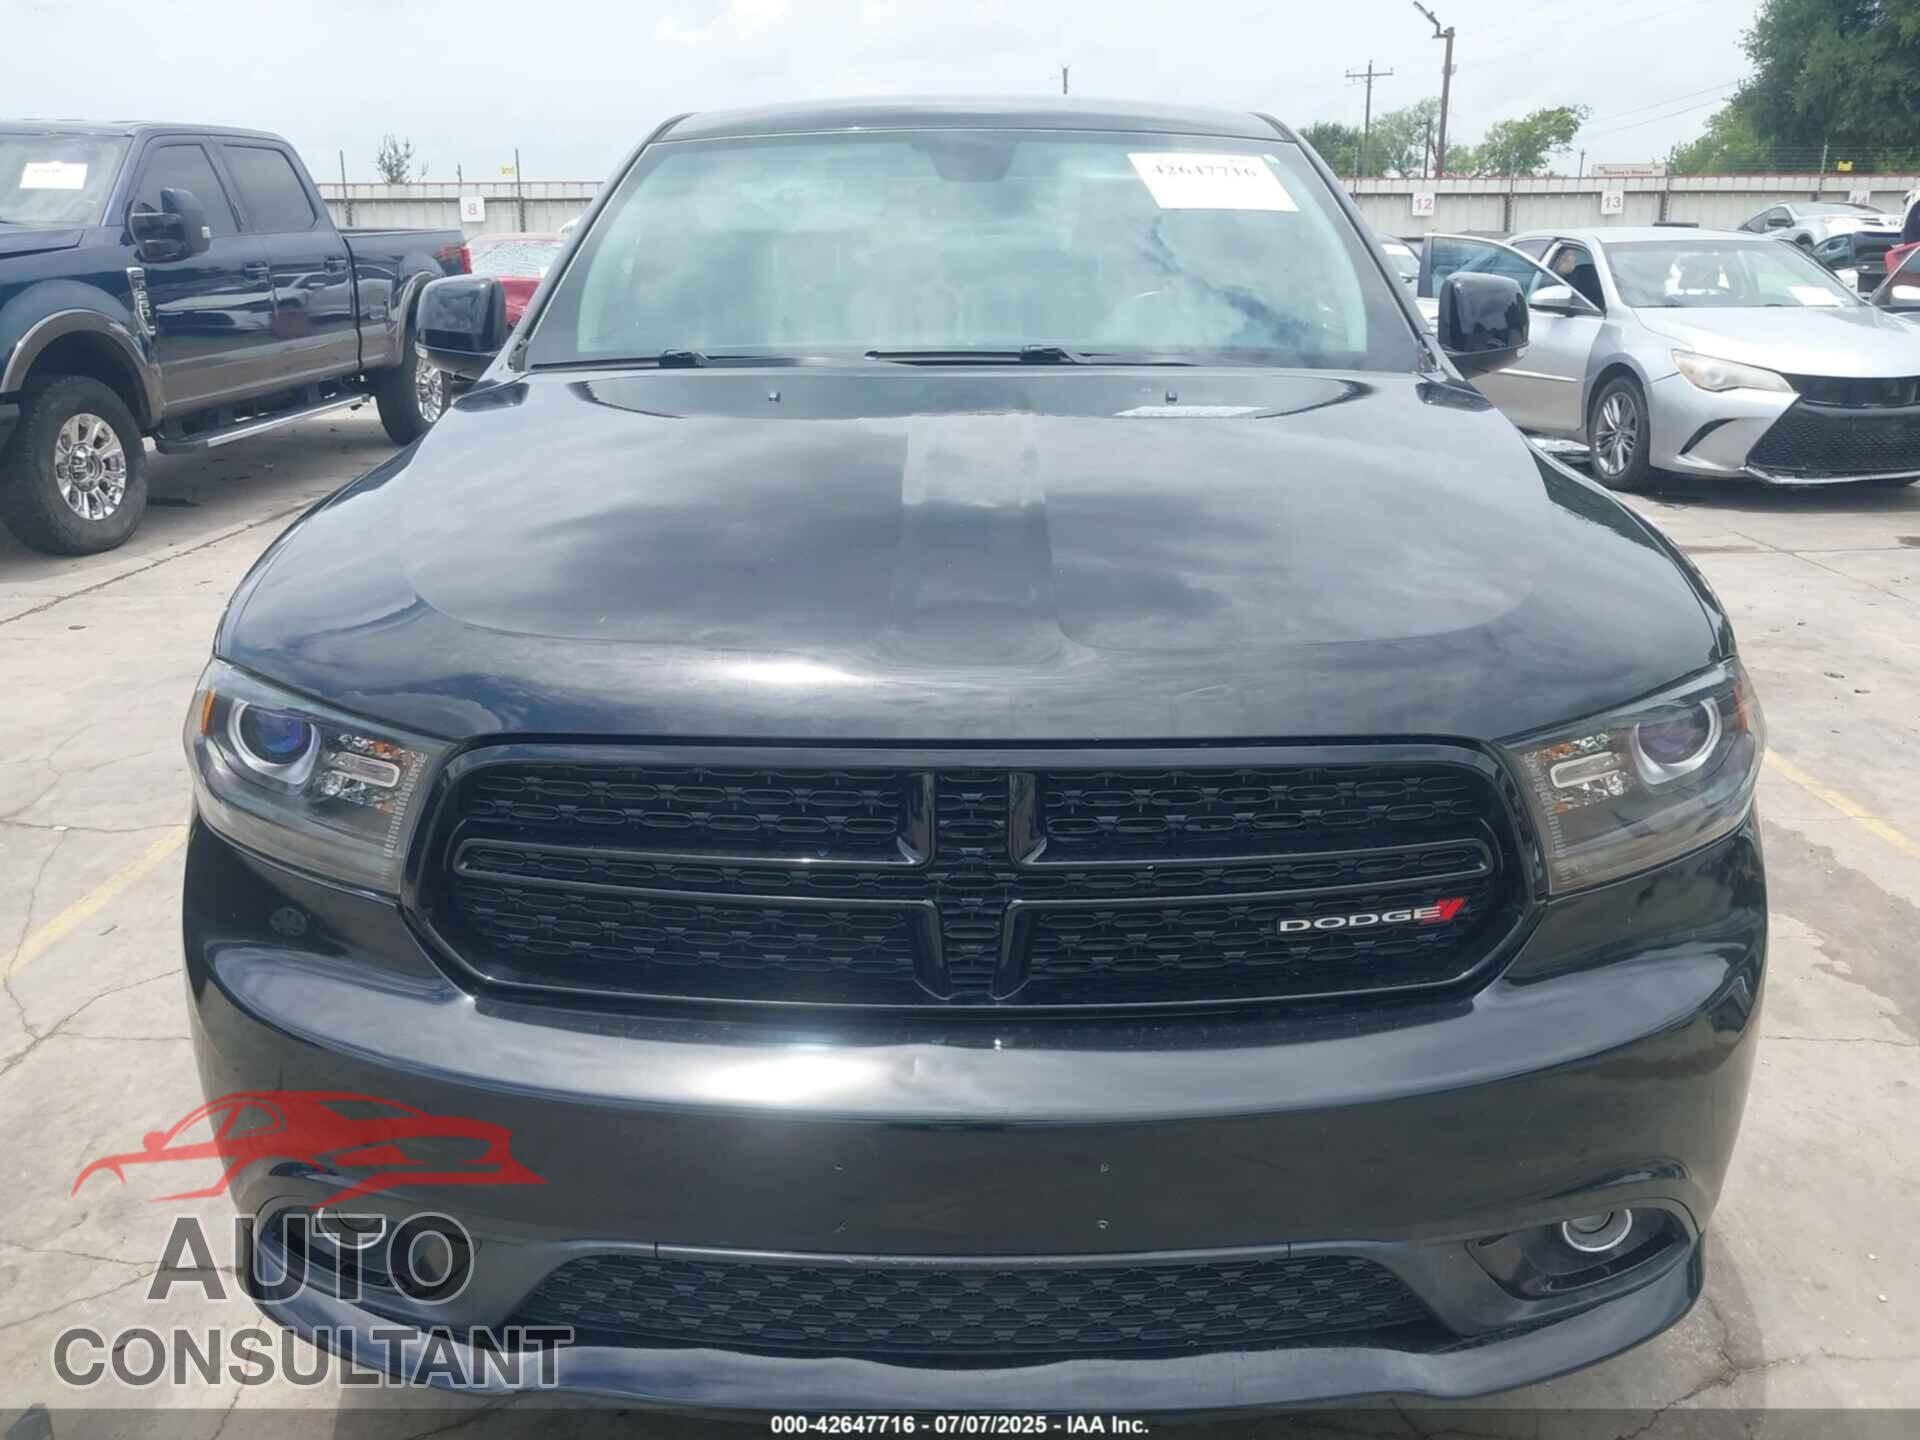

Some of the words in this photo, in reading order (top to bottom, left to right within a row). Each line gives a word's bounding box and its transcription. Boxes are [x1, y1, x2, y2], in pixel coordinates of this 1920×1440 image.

[1415, 198, 1433, 210] 12
[1605, 196, 1621, 208] 13
[1279, 905, 1441, 932] DODGE
